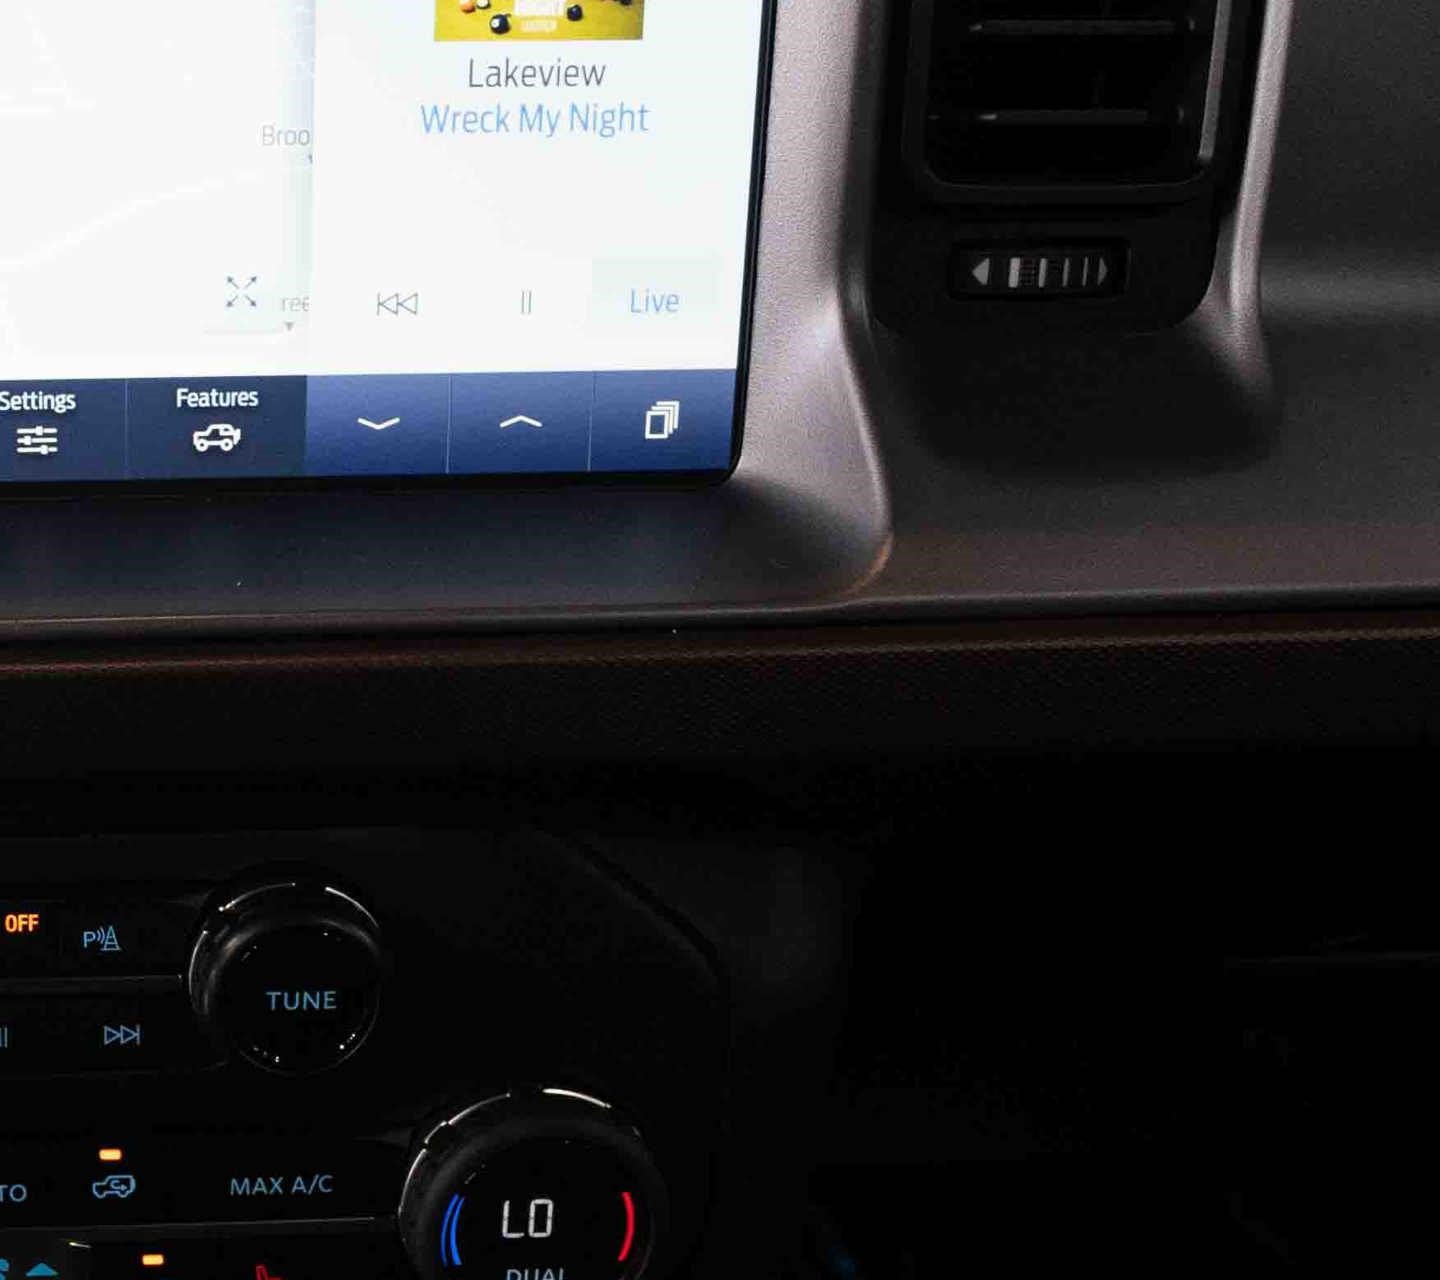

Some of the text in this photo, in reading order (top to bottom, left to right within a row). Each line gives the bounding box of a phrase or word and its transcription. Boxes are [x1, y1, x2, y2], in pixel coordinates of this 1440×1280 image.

[467, 57, 607, 89] Lakeview
[420, 101, 651, 139] Wreck My Night
[629, 287, 681, 314] Live
[175, 385, 260, 410] Features
[4, 913, 40, 933] OFF
[265, 990, 338, 1012] TUNE
[229, 1173, 334, 1196] MAX A/C
